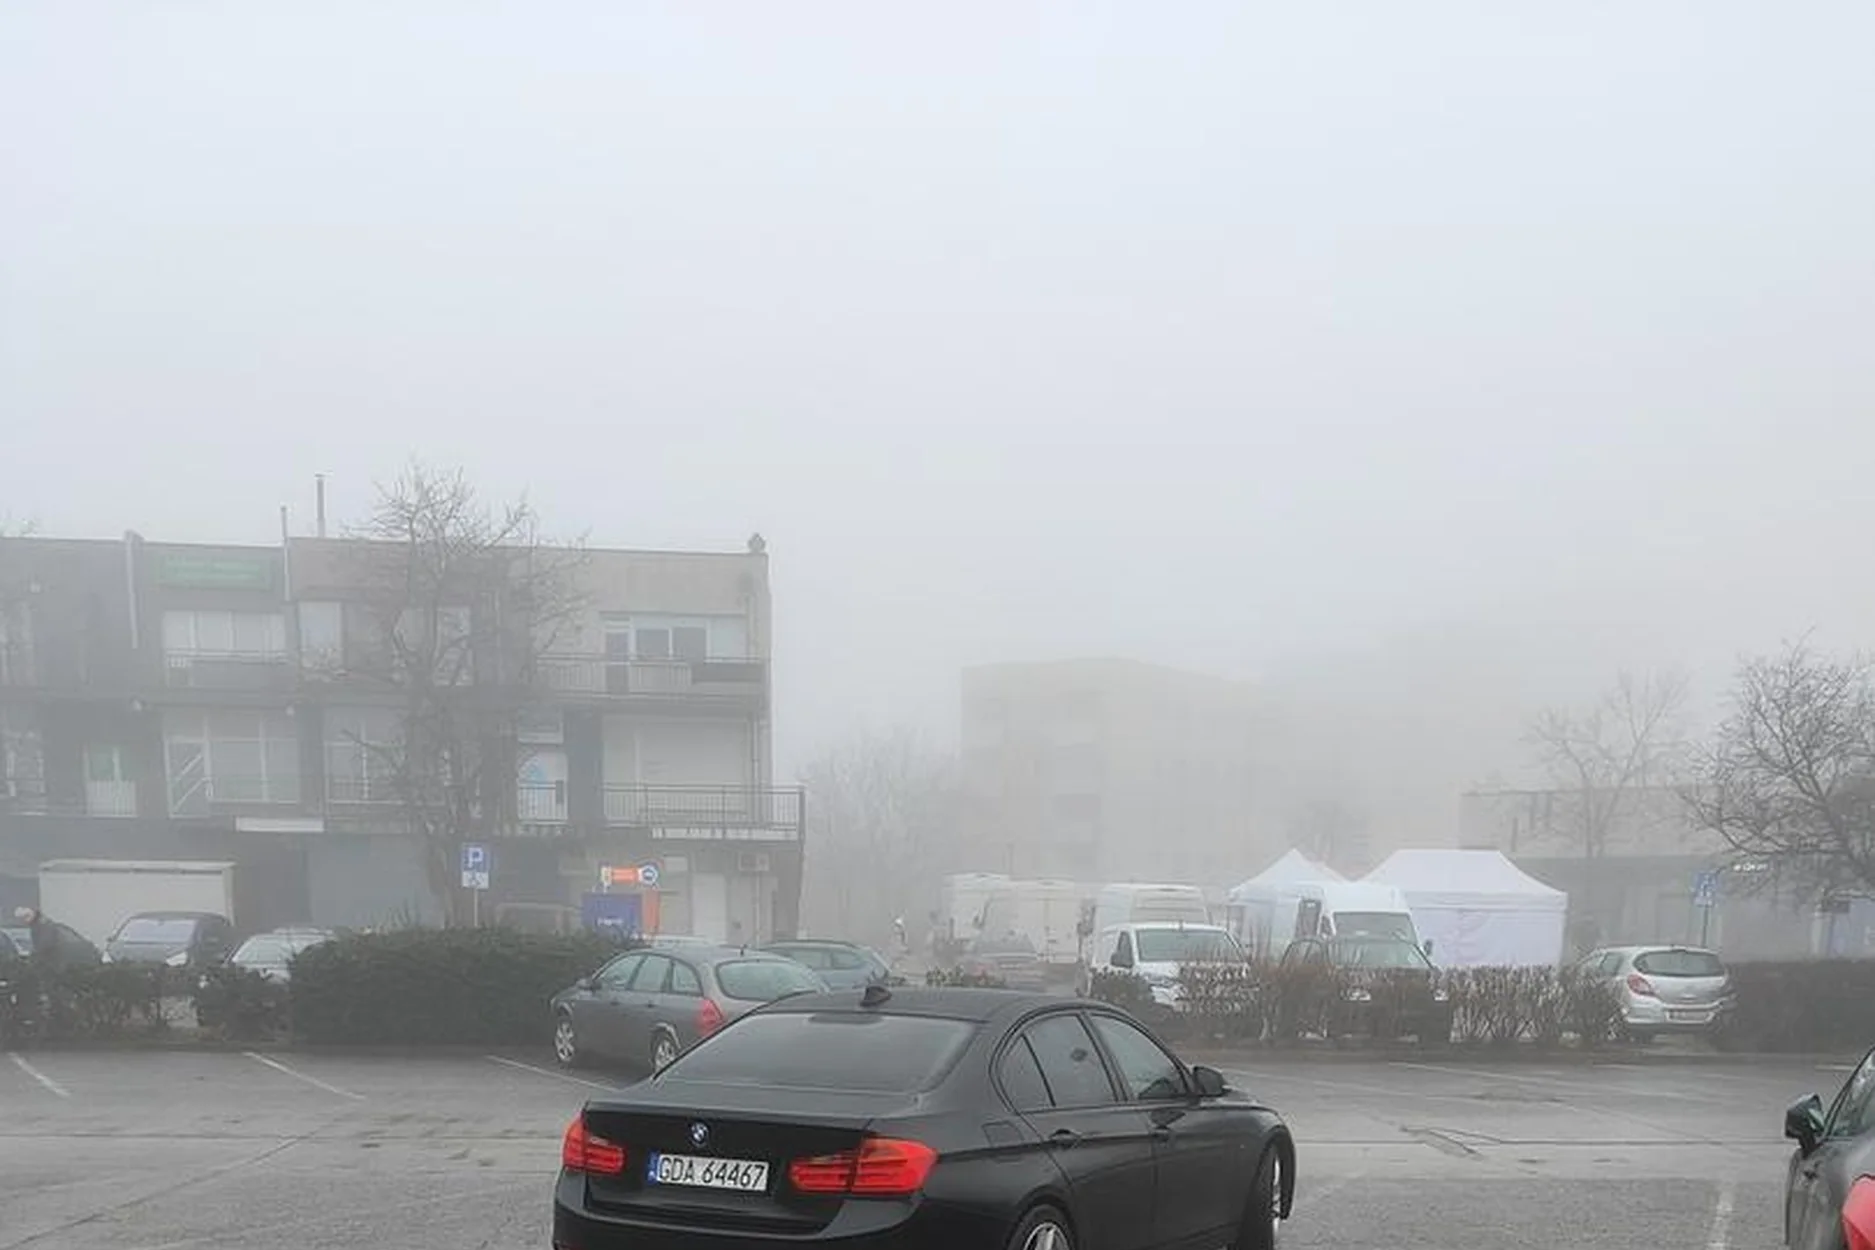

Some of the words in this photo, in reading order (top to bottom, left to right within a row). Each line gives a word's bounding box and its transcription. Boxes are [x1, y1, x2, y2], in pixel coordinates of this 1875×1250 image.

[468, 847, 484, 868] P
[660, 1157, 695, 1182] GDA
[702, 1160, 765, 1188] 64467
